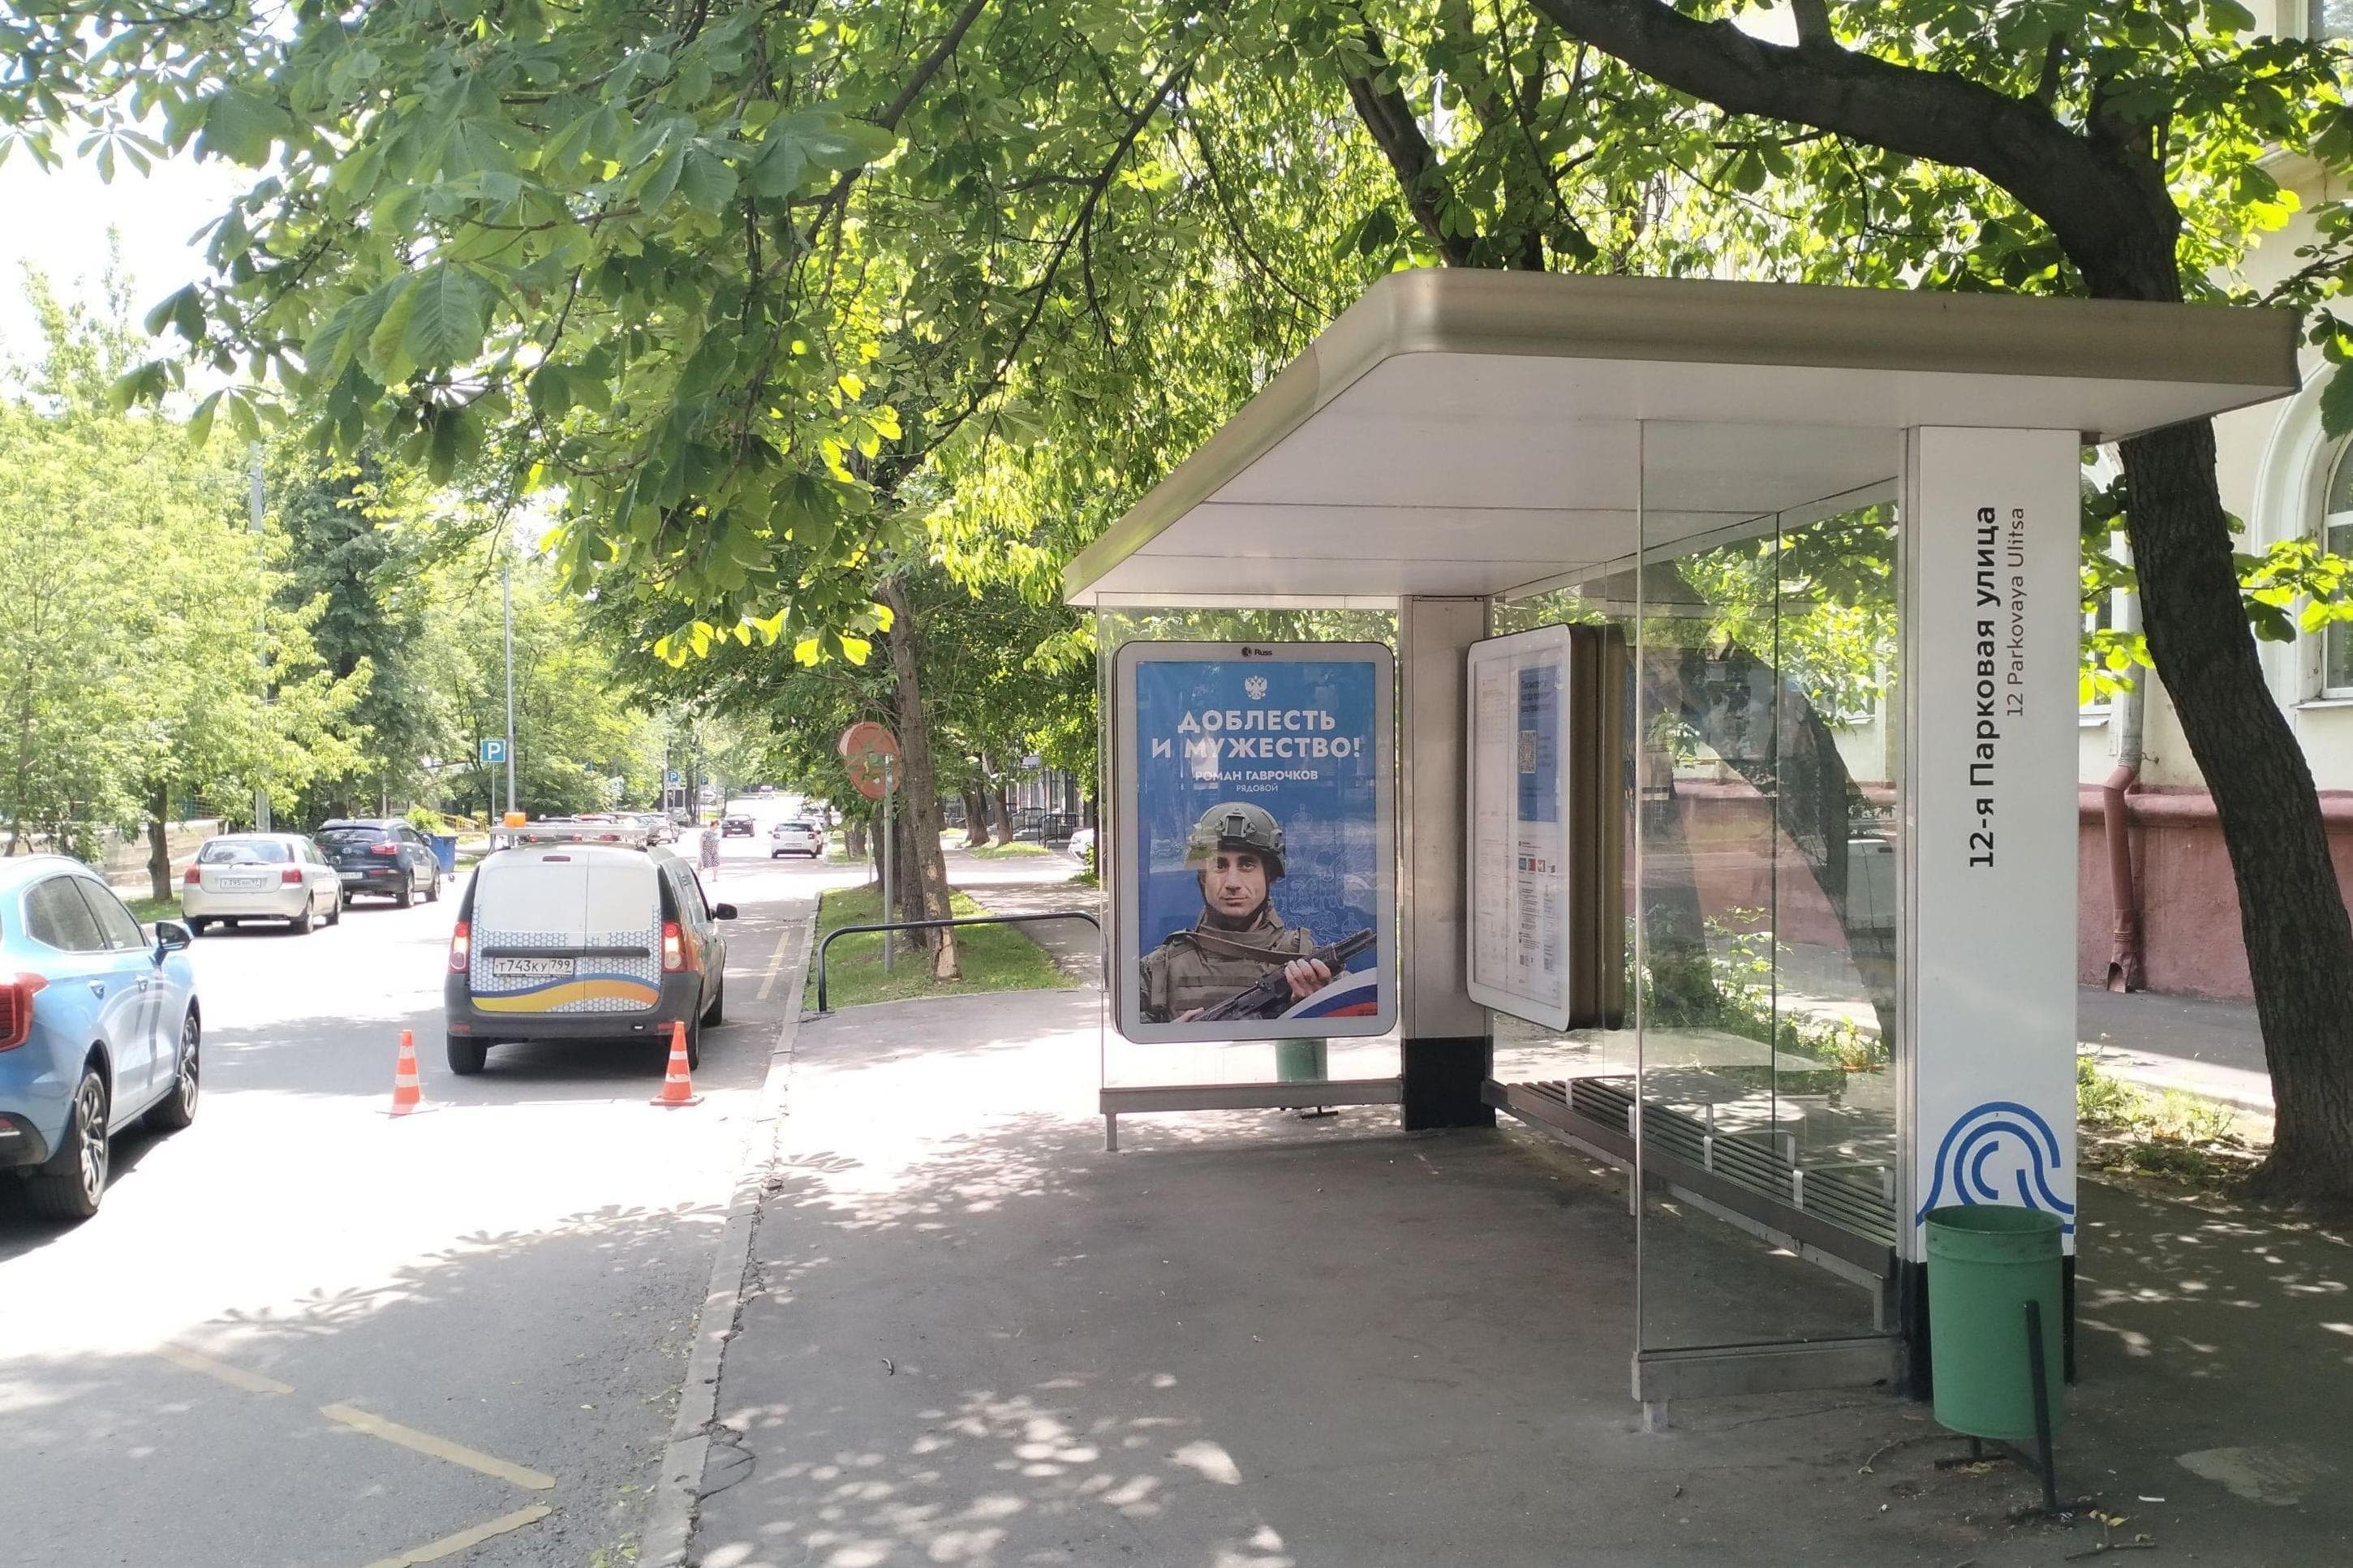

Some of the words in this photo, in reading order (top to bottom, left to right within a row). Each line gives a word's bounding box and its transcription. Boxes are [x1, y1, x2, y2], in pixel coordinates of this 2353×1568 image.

[2007, 508, 2024, 568] Ulitsa
[1977, 506, 2001, 608] улица
[2007, 575, 2027, 685] Parkovaya
[1969, 620, 2000, 786] Парковая
[2007, 693, 2024, 717] 12
[1177, 709, 1336, 734] ДОБЛЕСТЬ
[1152, 737, 1172, 758] И
[1185, 737, 1361, 758] МУЖЕСТВО!
[1195, 771, 1241, 781] РОМАН
[1246, 770, 1318, 781] ГАВРОЧКОВ
[1236, 783, 1279, 793] РЯДОВОЙ
[1969, 798, 1995, 868] 12-я
[499, 959, 548, 973] Т743КУ
[551, 959, 570, 970] 799
